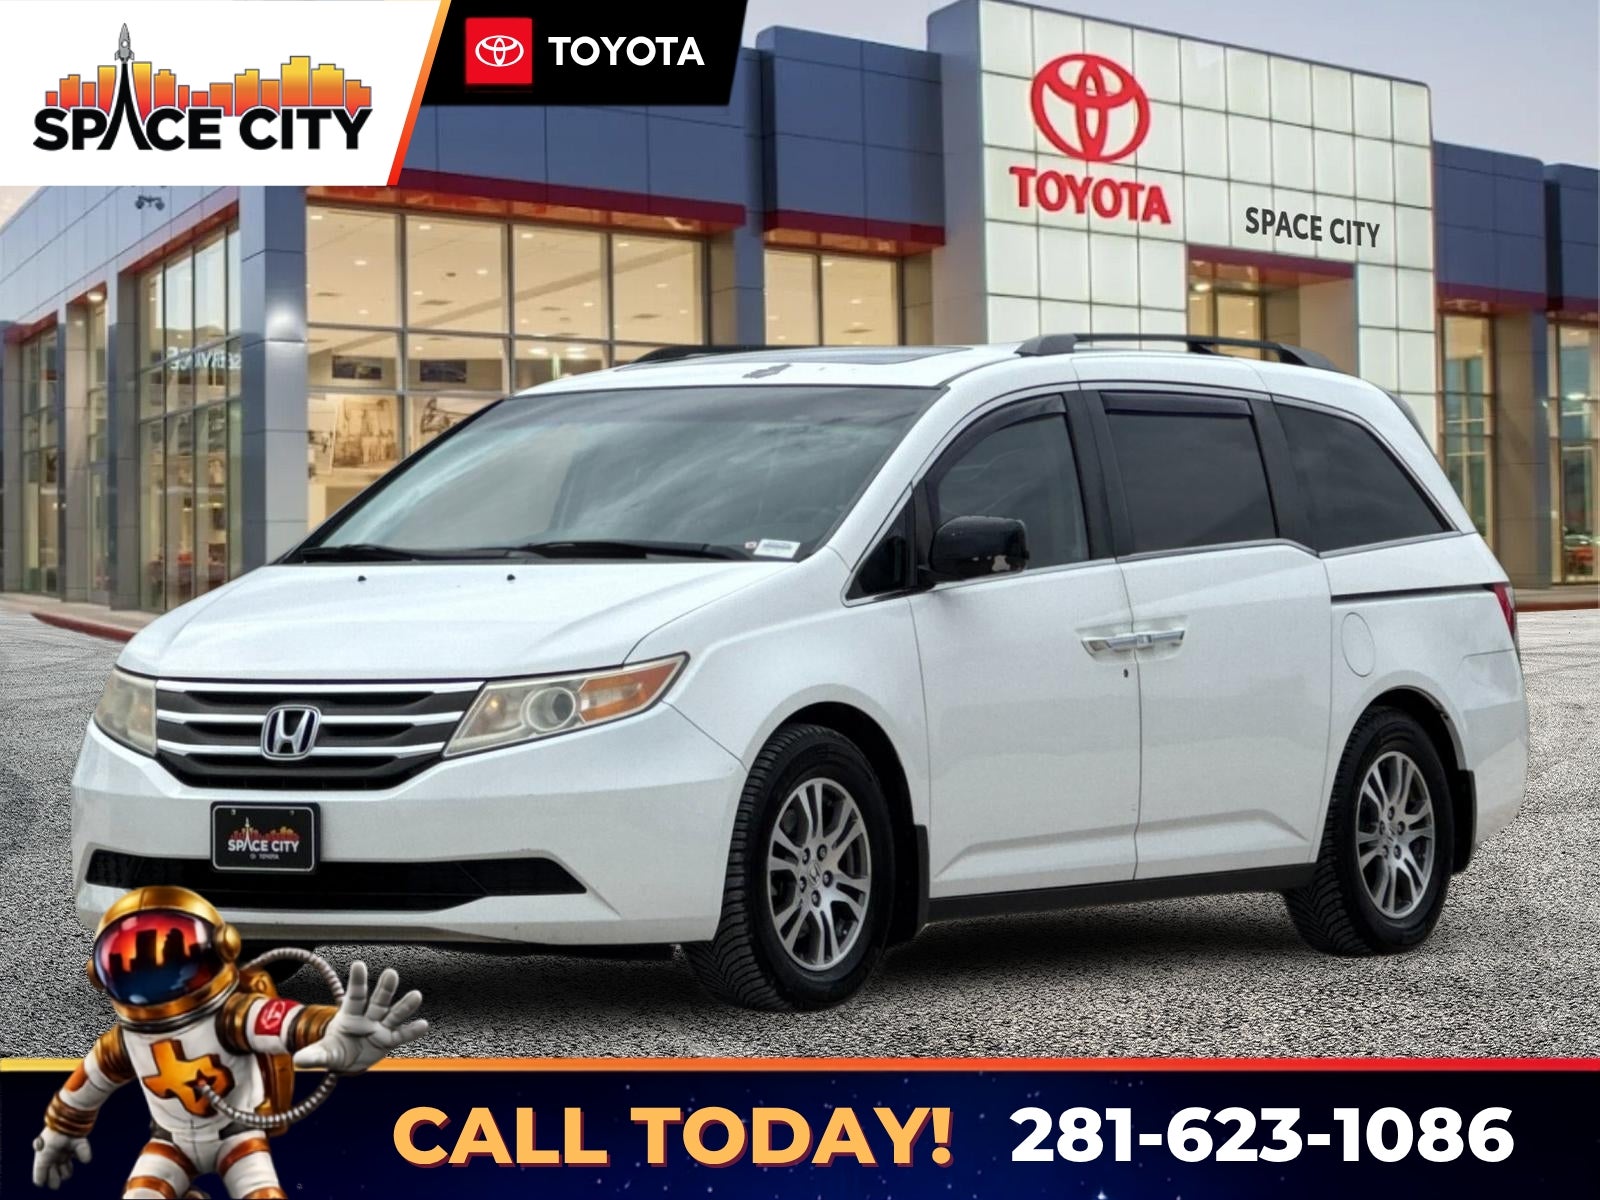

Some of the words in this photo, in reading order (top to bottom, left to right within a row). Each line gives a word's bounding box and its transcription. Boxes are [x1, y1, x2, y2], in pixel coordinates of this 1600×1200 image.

[1009, 166, 1171, 224] TOYOTA
[1245, 206, 1323, 242] SPACE
[1329, 217, 1380, 248] CITY
[228, 839, 268, 852] SPACE
[271, 840, 299, 852] CITY
